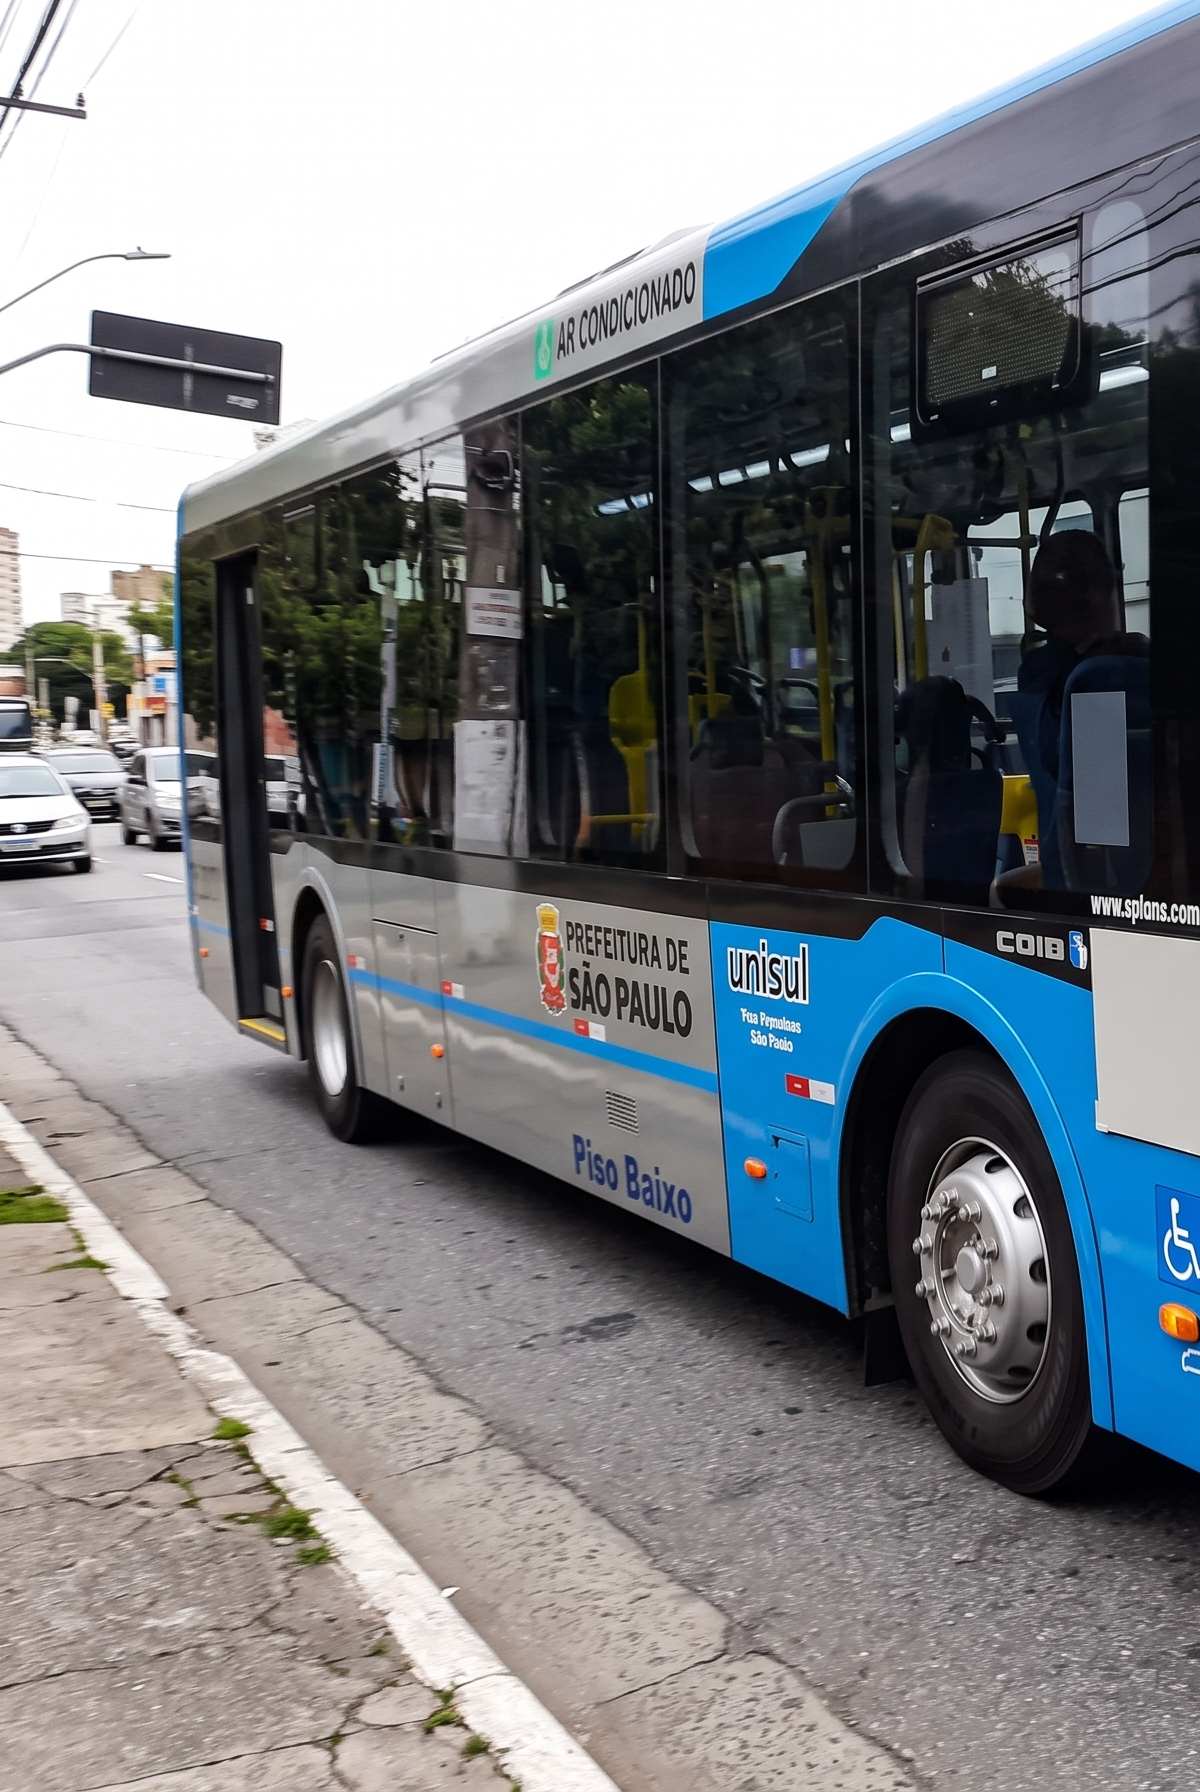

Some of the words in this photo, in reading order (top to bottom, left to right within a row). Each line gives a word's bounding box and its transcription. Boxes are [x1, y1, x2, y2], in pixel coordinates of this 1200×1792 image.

[557, 317, 575, 360] AR
[579, 261, 696, 350] CONDICIONADO
[566, 921, 662, 969] PREFEITURA
[665, 937, 690, 975] DE
[727, 938, 809, 1005] unisul
[568, 960, 611, 1018] SÃO
[614, 976, 693, 1038] PAULO
[572, 1133, 618, 1191] Piso
[624, 1154, 692, 1224] Baixo
